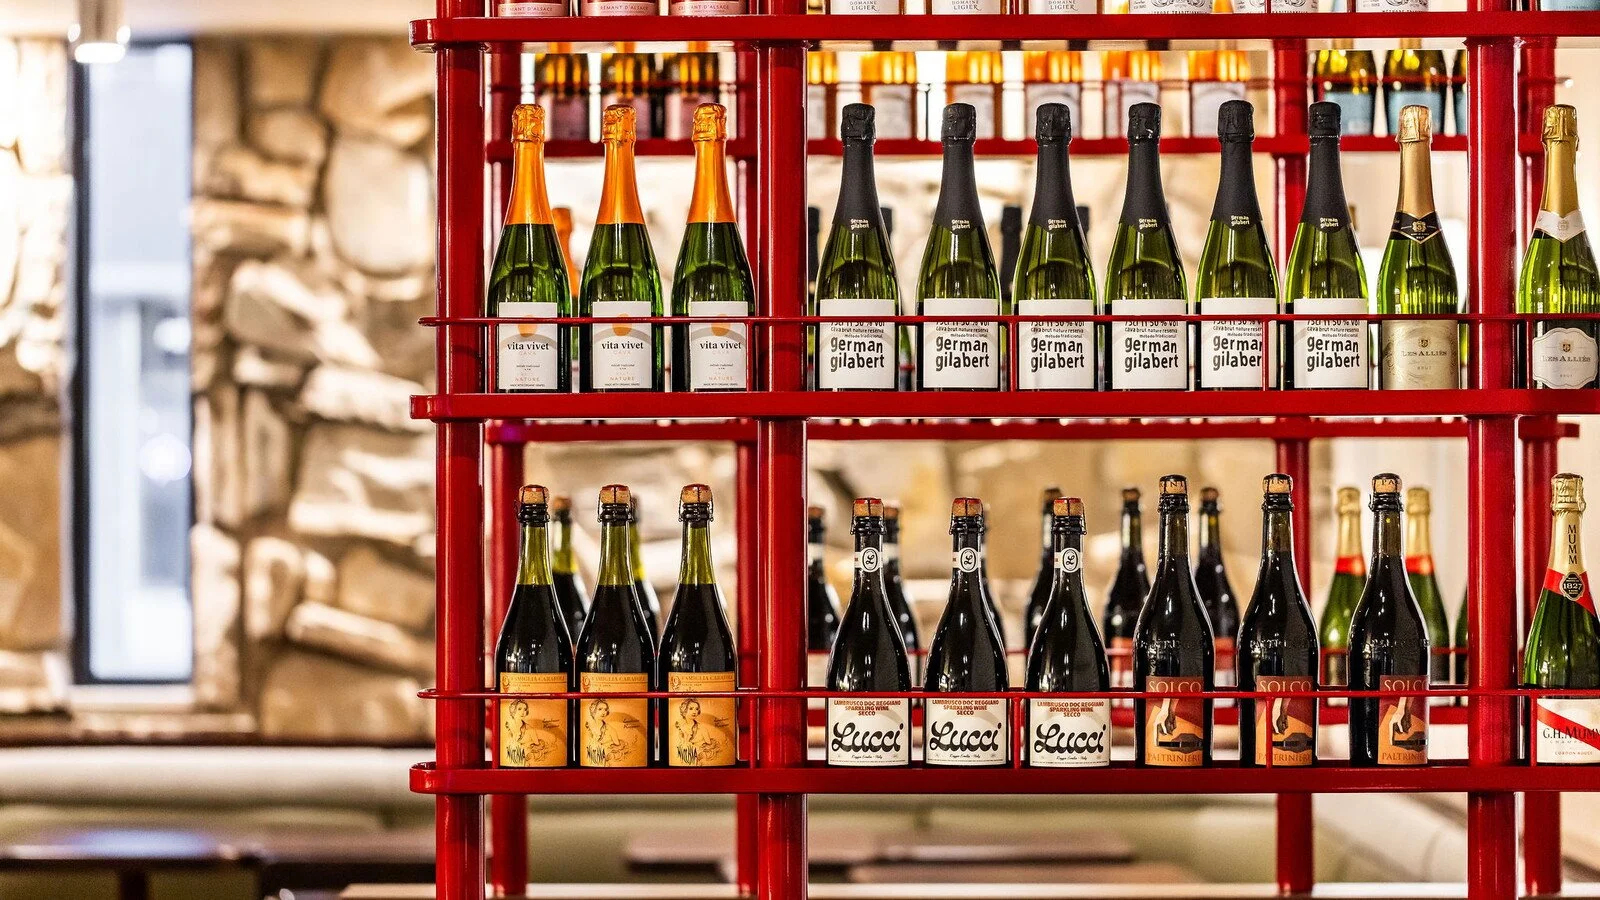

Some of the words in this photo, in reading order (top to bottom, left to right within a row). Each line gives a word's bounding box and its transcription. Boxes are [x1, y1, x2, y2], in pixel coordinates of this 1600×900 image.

[507, 342, 524, 350] vita
[526, 342, 549, 350] vivet
[602, 340, 619, 350] vita
[622, 340, 644, 350] vivet
[700, 340, 718, 350] vita
[720, 340, 742, 350] vivet
[831, 337, 883, 353] german
[936, 336, 988, 353] german
[1031, 338, 1083, 353] german
[1125, 338, 1177, 353] german
[1307, 336, 1358, 352] german
[831, 352, 884, 372] gilabert
[936, 352, 990, 372] gilabert
[1031, 352, 1084, 372] gilabert
[1125, 352, 1178, 372] gilabert
[1213, 351, 1262, 371] gilaber
[1307, 352, 1360, 372] gilabert
[1568, 524, 1578, 564] MUMM
[1148, 681, 1202, 692] SOLCO
[1260, 680, 1312, 692] SOLCO
[832, 722, 904, 752] Lucci
[930, 721, 1002, 752] Lucci
[1034, 724, 1106, 754] Lucci
